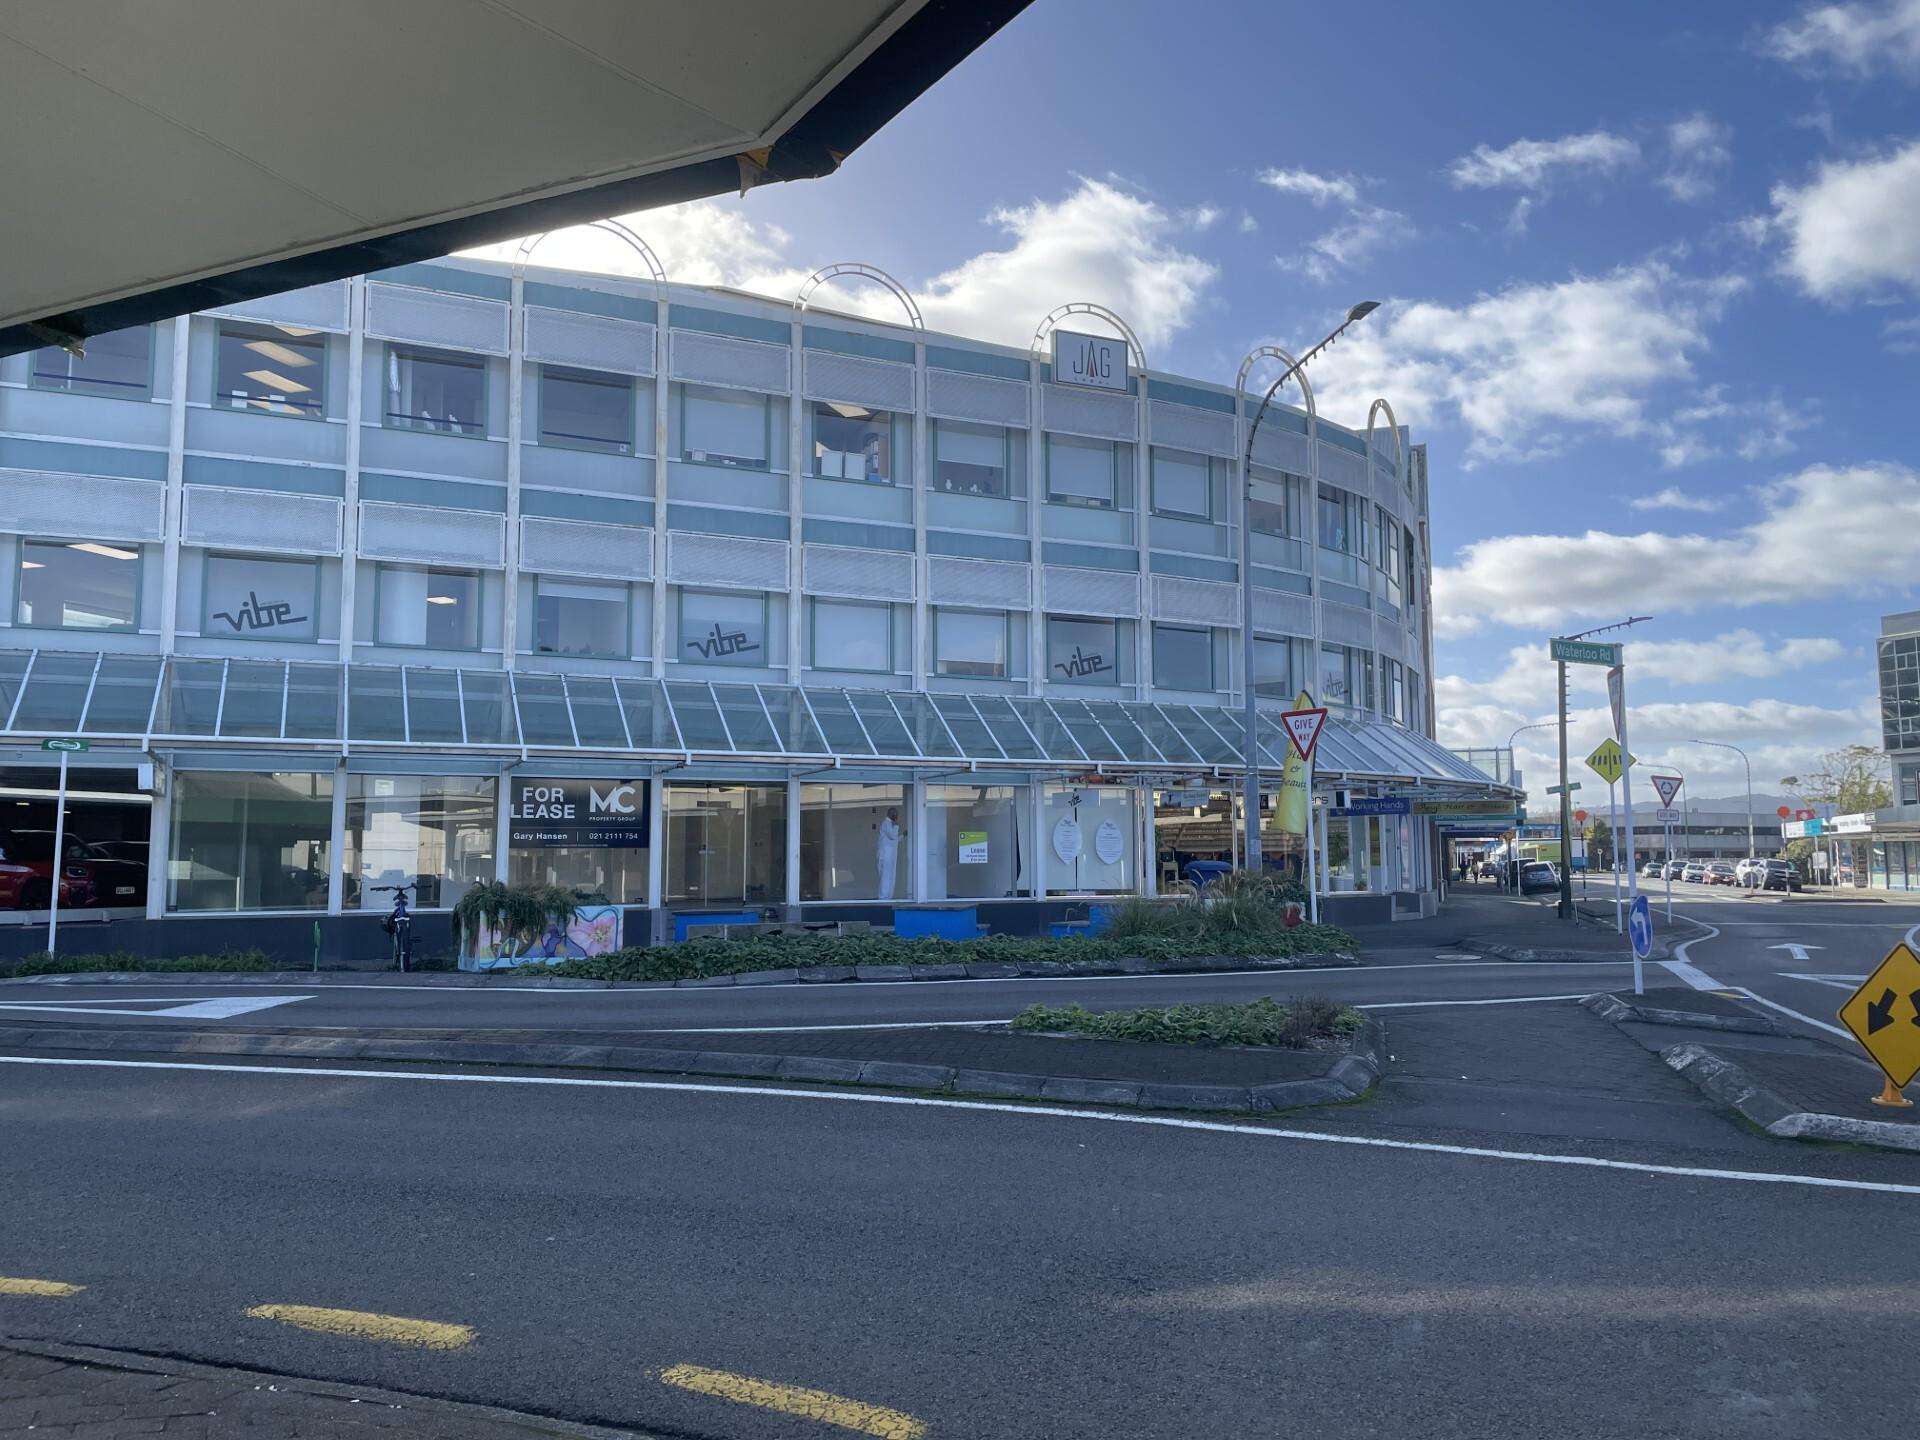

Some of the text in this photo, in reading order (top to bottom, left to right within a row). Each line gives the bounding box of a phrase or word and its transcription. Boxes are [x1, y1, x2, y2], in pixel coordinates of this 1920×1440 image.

[1073, 341, 1110, 378] JAG
[213, 591, 308, 632] vibe
[687, 623, 759, 658] vibe
[1556, 644, 1610, 661] Waterloo Rd
[1054, 646, 1112, 678] vibe
[1294, 719, 1313, 730] GIVE
[1298, 733, 1310, 742] WAY
[522, 787, 564, 802] FOR
[589, 786, 636, 814] MC
[511, 804, 576, 819] LEASE
[513, 832, 568, 841] Gary Hansen
[589, 832, 638, 840] 021 2111 754
